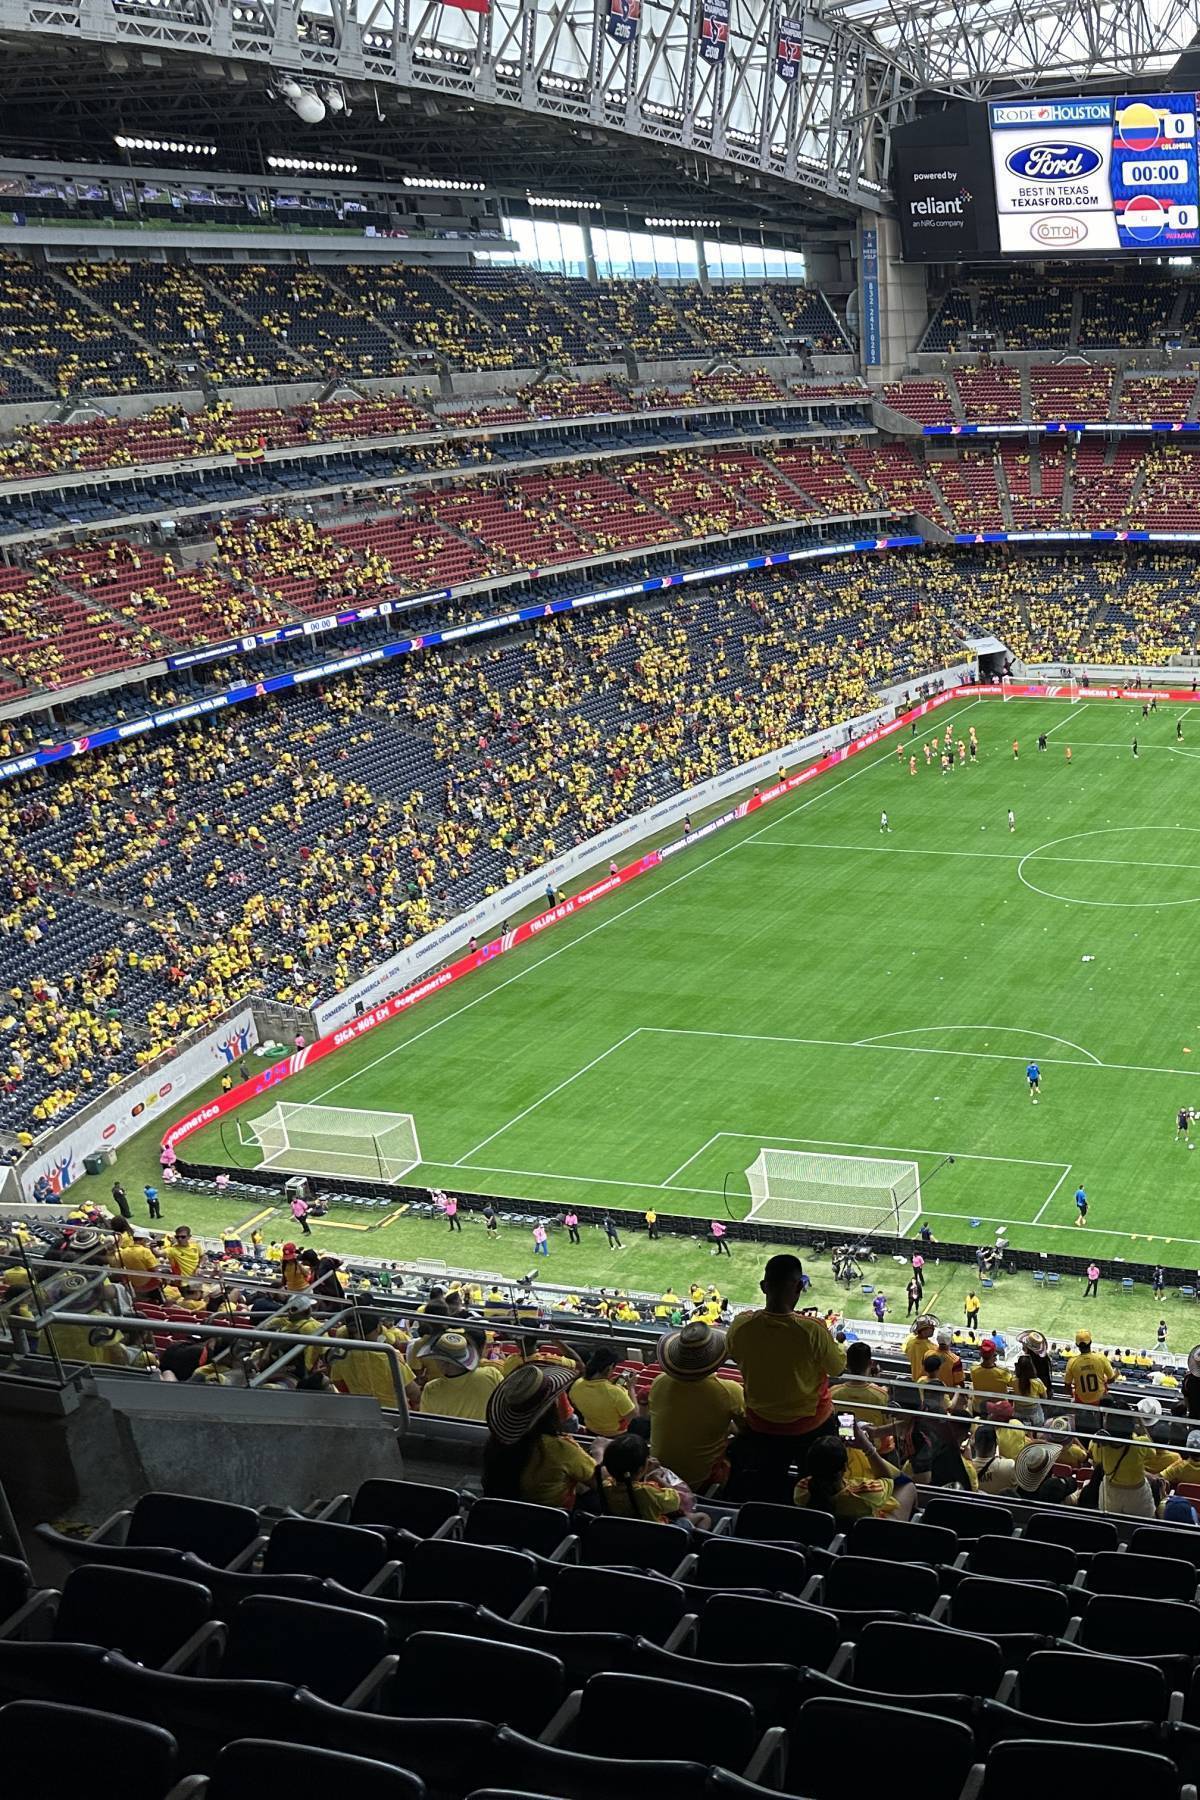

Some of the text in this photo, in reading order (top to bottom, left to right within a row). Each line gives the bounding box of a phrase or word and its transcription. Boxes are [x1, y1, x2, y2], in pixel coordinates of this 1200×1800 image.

[1174, 119, 1184, 134] 0
[1024, 147, 1084, 176] Ford
[914, 171, 958, 182] powered by
[1132, 166, 1179, 182] 00:00
[1019, 186, 1088, 196] BEST IN TEXAS
[910, 196, 964, 214] reliant
[1011, 196, 1099, 207] TEXASFORD.COM
[936, 220, 964, 228] company
[1178, 210, 1188, 226] 0
[348, 994, 360, 1005] COPA
[1080, 1374, 1099, 1392] 10
